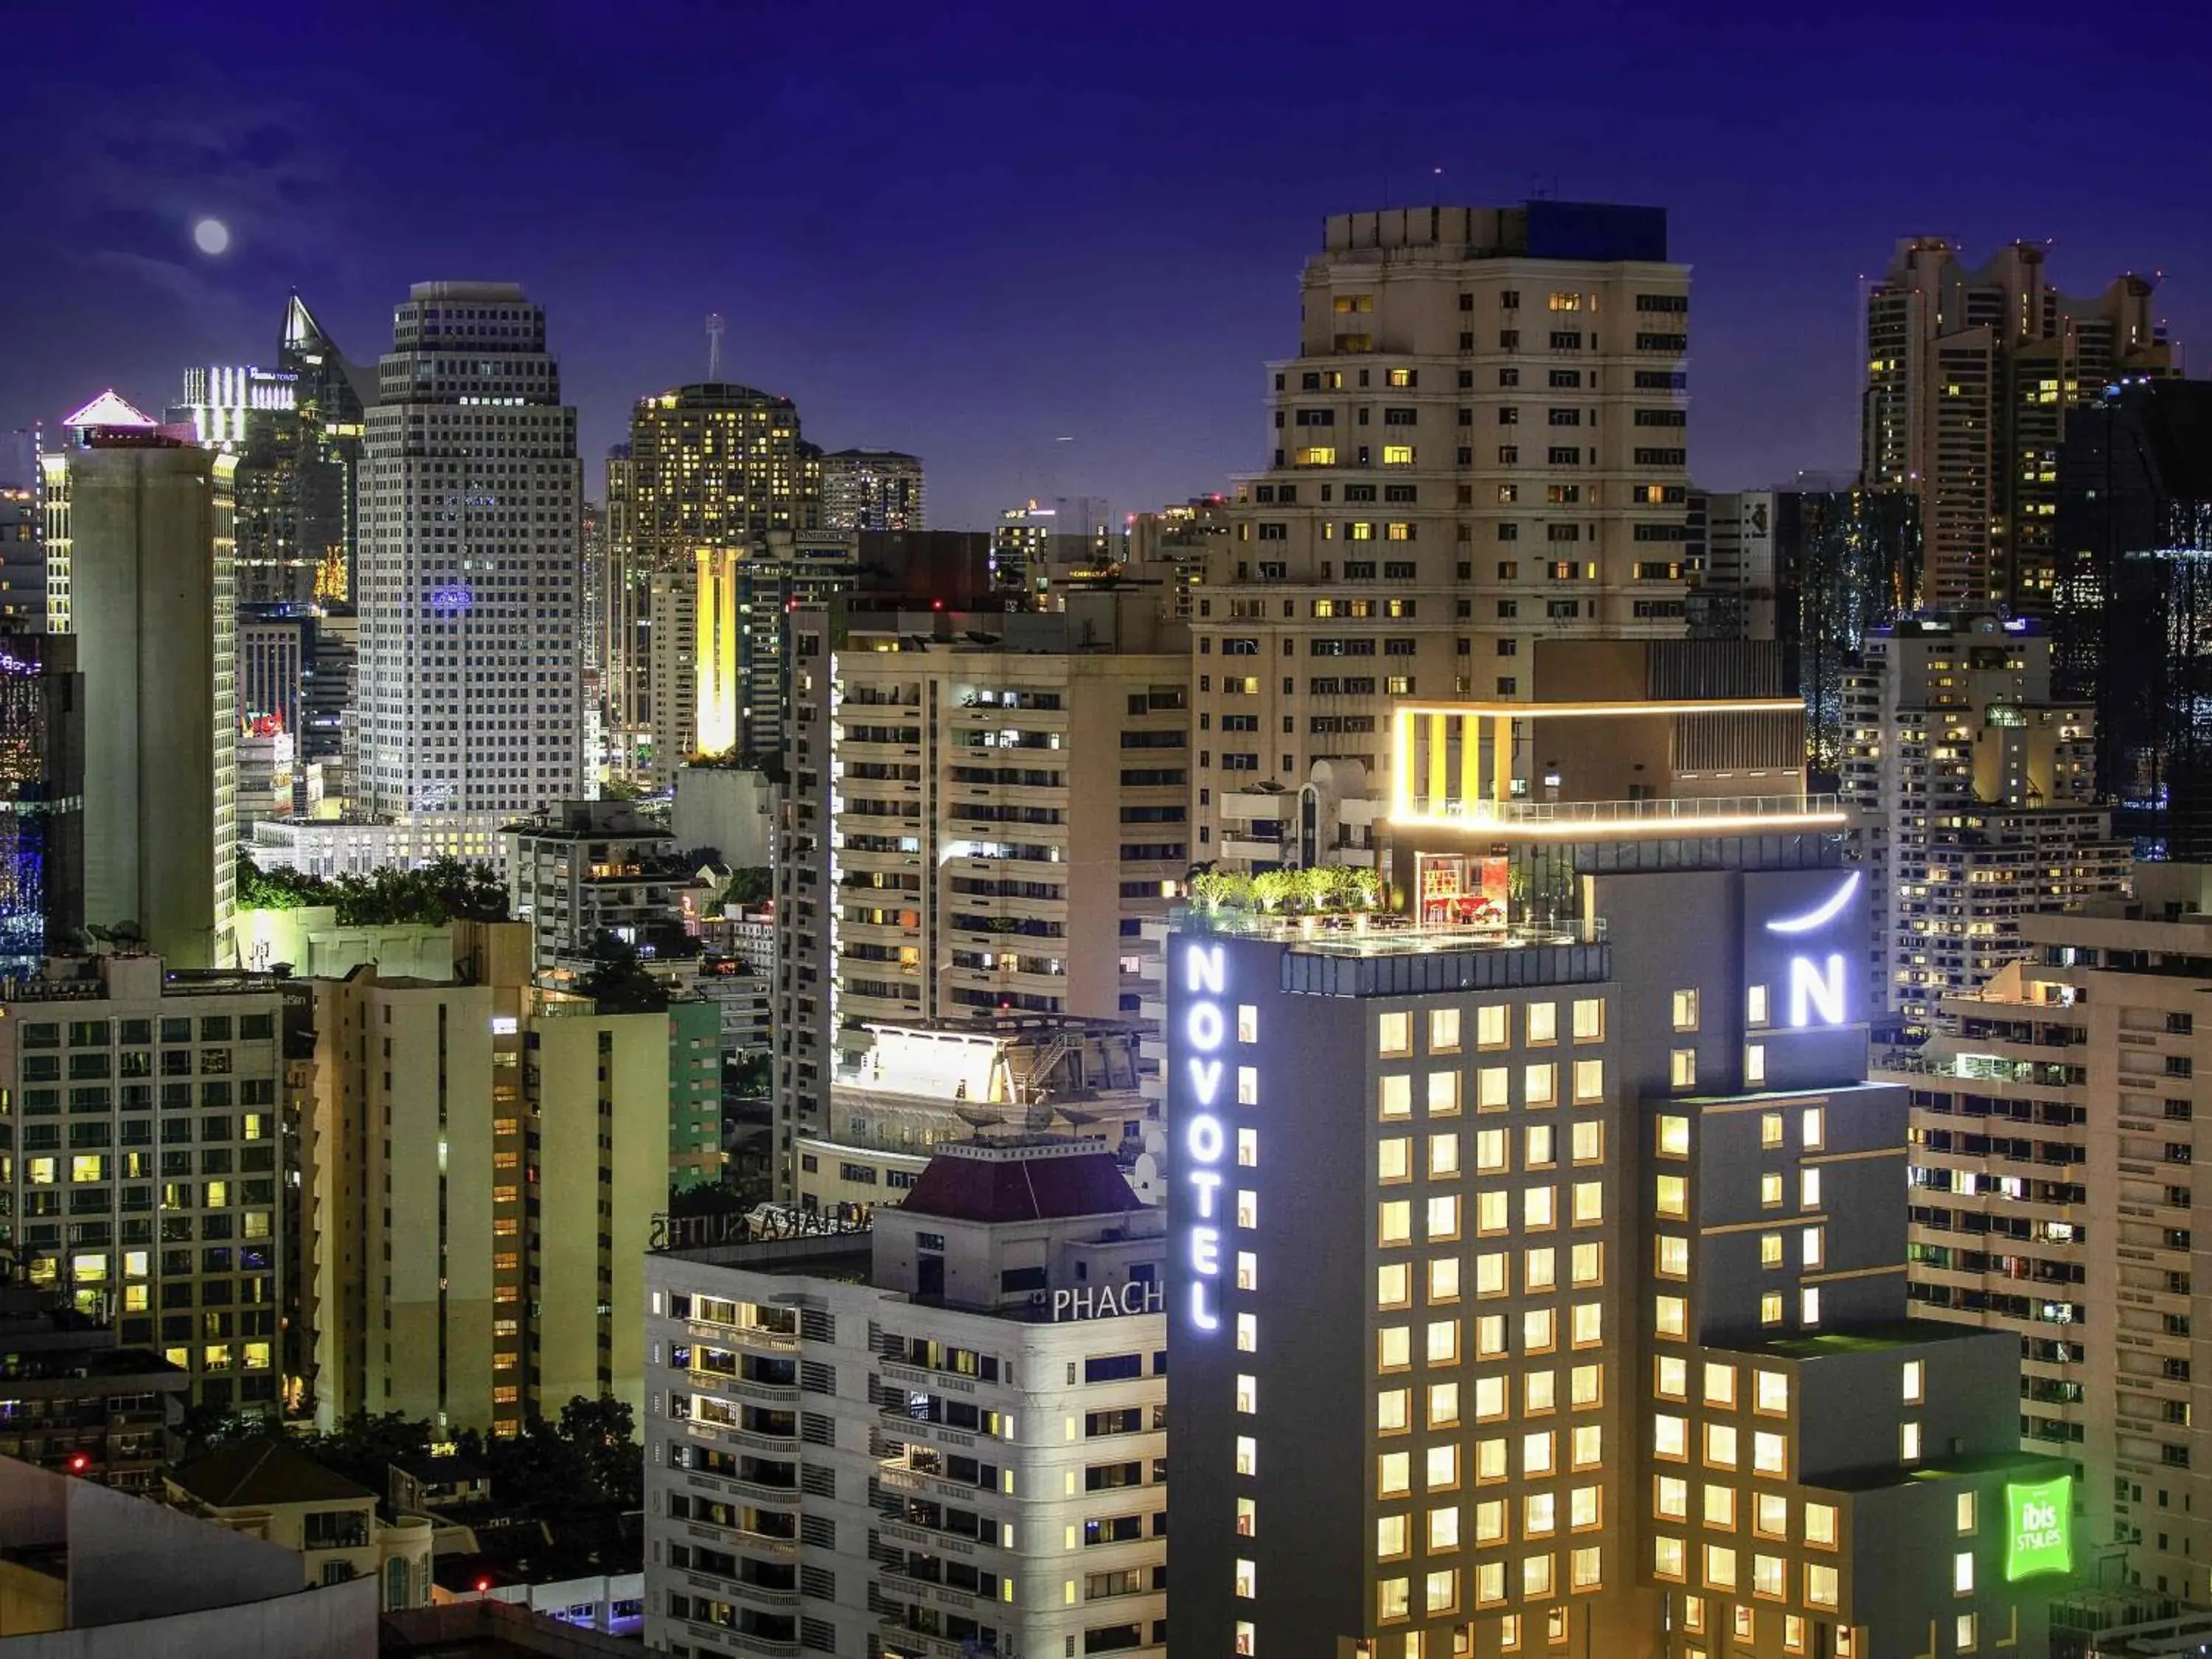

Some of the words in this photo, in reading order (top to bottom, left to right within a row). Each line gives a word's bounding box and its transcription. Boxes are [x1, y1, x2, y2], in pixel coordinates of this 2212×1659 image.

[1790, 953, 1845, 1027] N
[1186, 945, 1225, 1330] NOVOTEL
[2023, 1500, 2056, 1531] ibis
